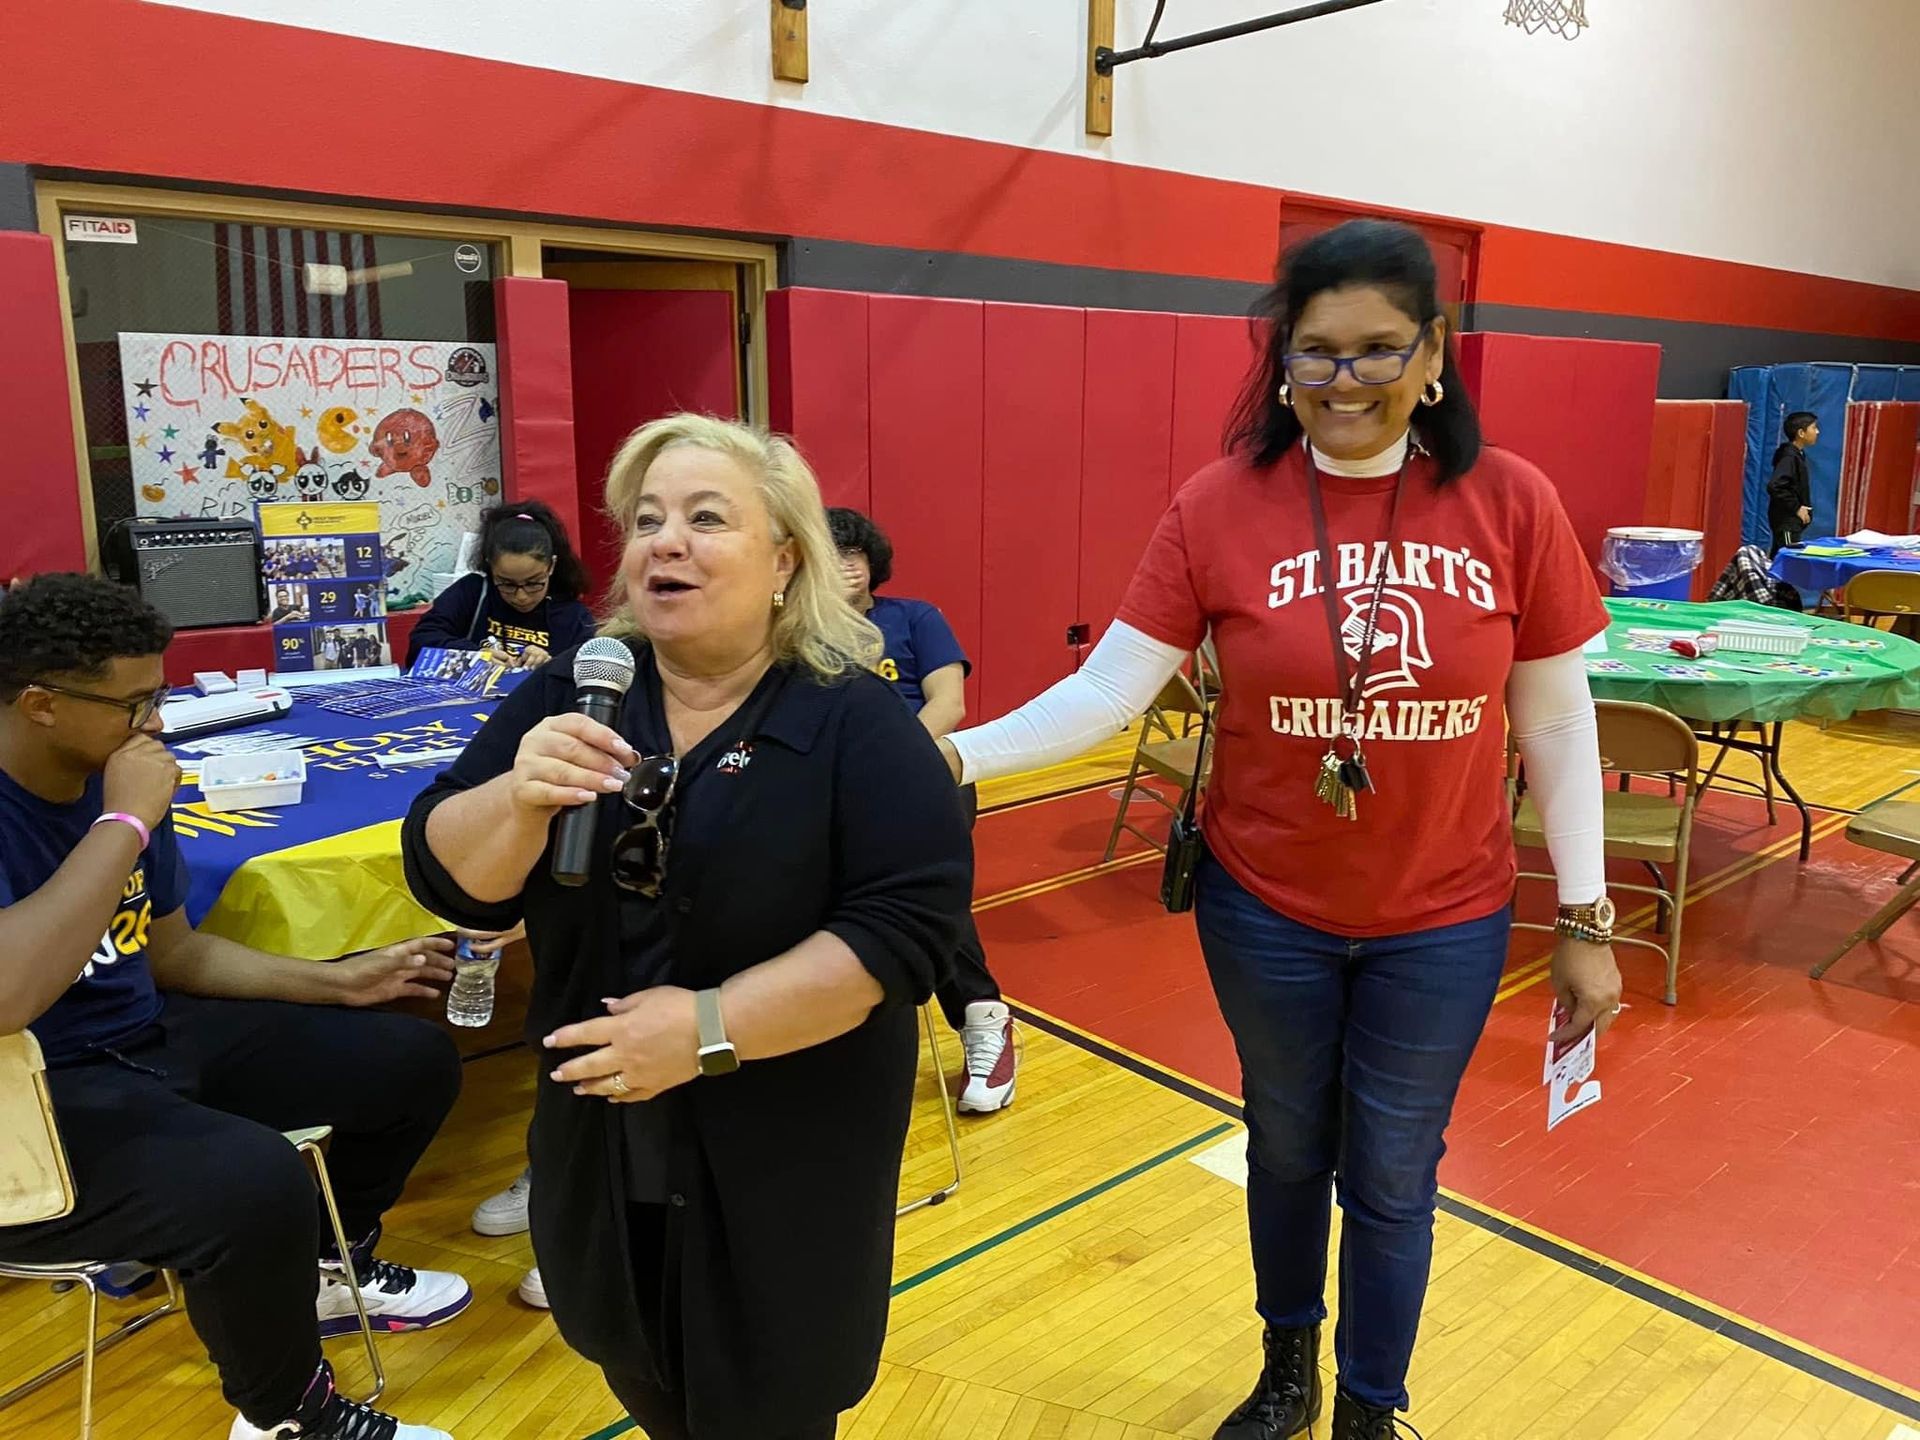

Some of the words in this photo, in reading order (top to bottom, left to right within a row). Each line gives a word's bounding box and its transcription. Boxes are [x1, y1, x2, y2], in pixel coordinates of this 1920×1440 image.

[69, 219, 131, 234] FITAID
[160, 341, 442, 412] CRUSADERS
[356, 546, 373, 559] 12
[320, 592, 336, 604] 29
[1267, 549, 1326, 610] ST.
[1336, 541, 1496, 611] BART'S
[1269, 695, 1488, 741] CRUSADERS
[303, 719, 461, 763] HOLY
